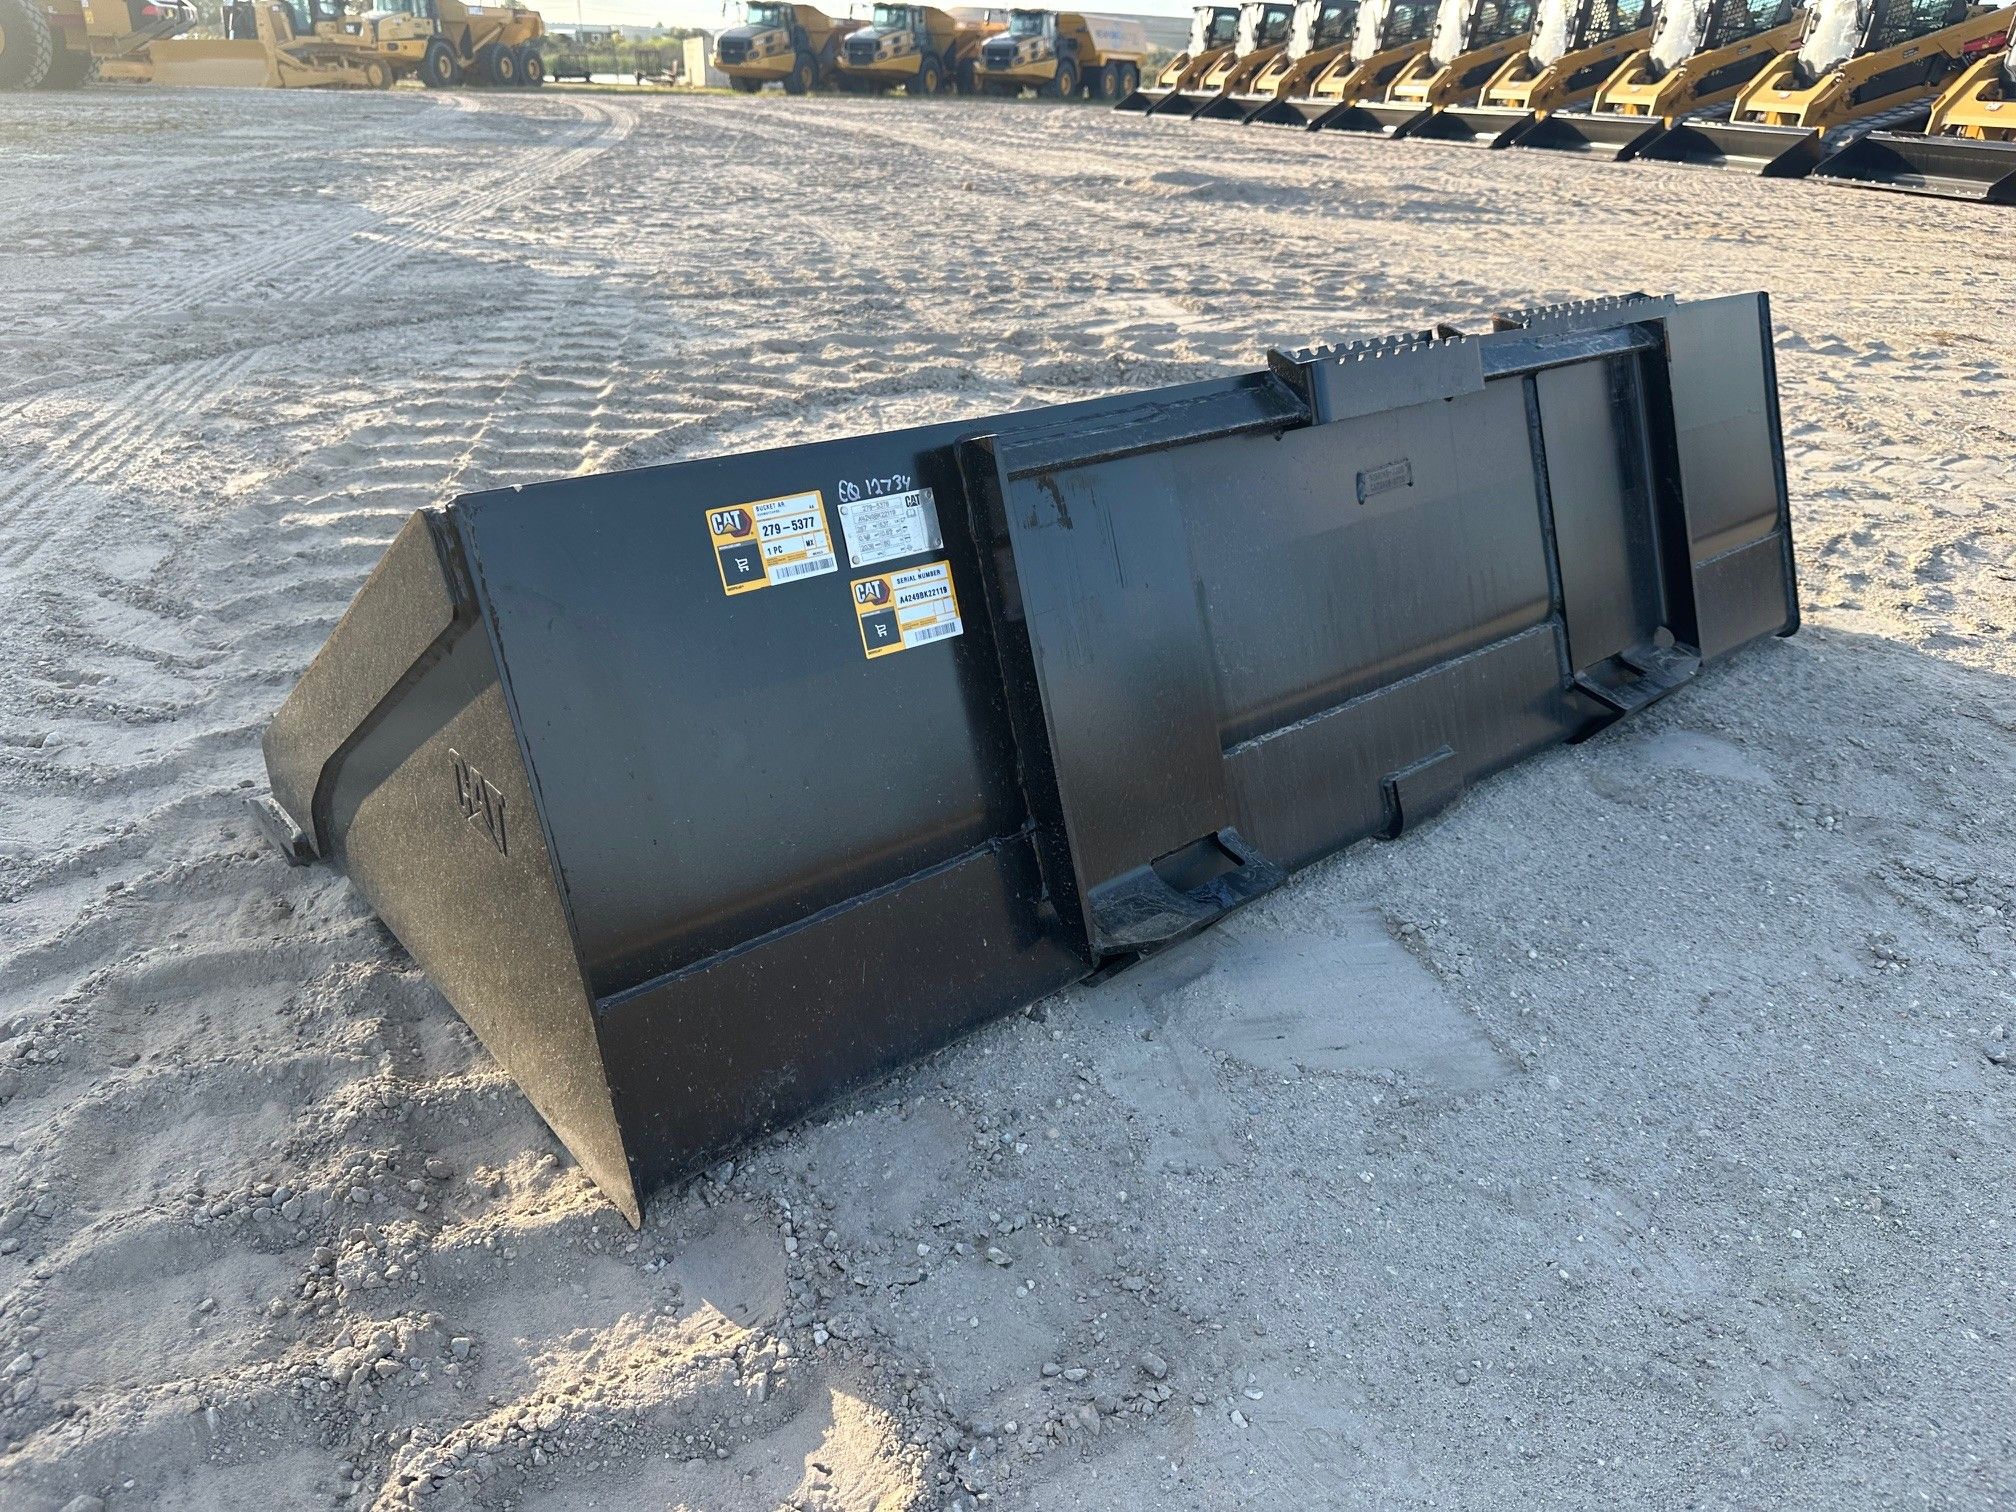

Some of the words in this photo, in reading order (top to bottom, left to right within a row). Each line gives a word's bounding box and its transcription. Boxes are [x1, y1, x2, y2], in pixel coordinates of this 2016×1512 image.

[865, 474, 911, 495] 12734
[756, 503, 776, 511] BUCKET
[905, 494, 921, 508] CAT
[712, 510, 741, 534] CAT
[774, 545, 783, 554] PC
[896, 576, 917, 585] SERIAL
[917, 569, 941, 580] NUMBER
[855, 581, 881, 604] CAT
[449, 748, 507, 857] CAT
